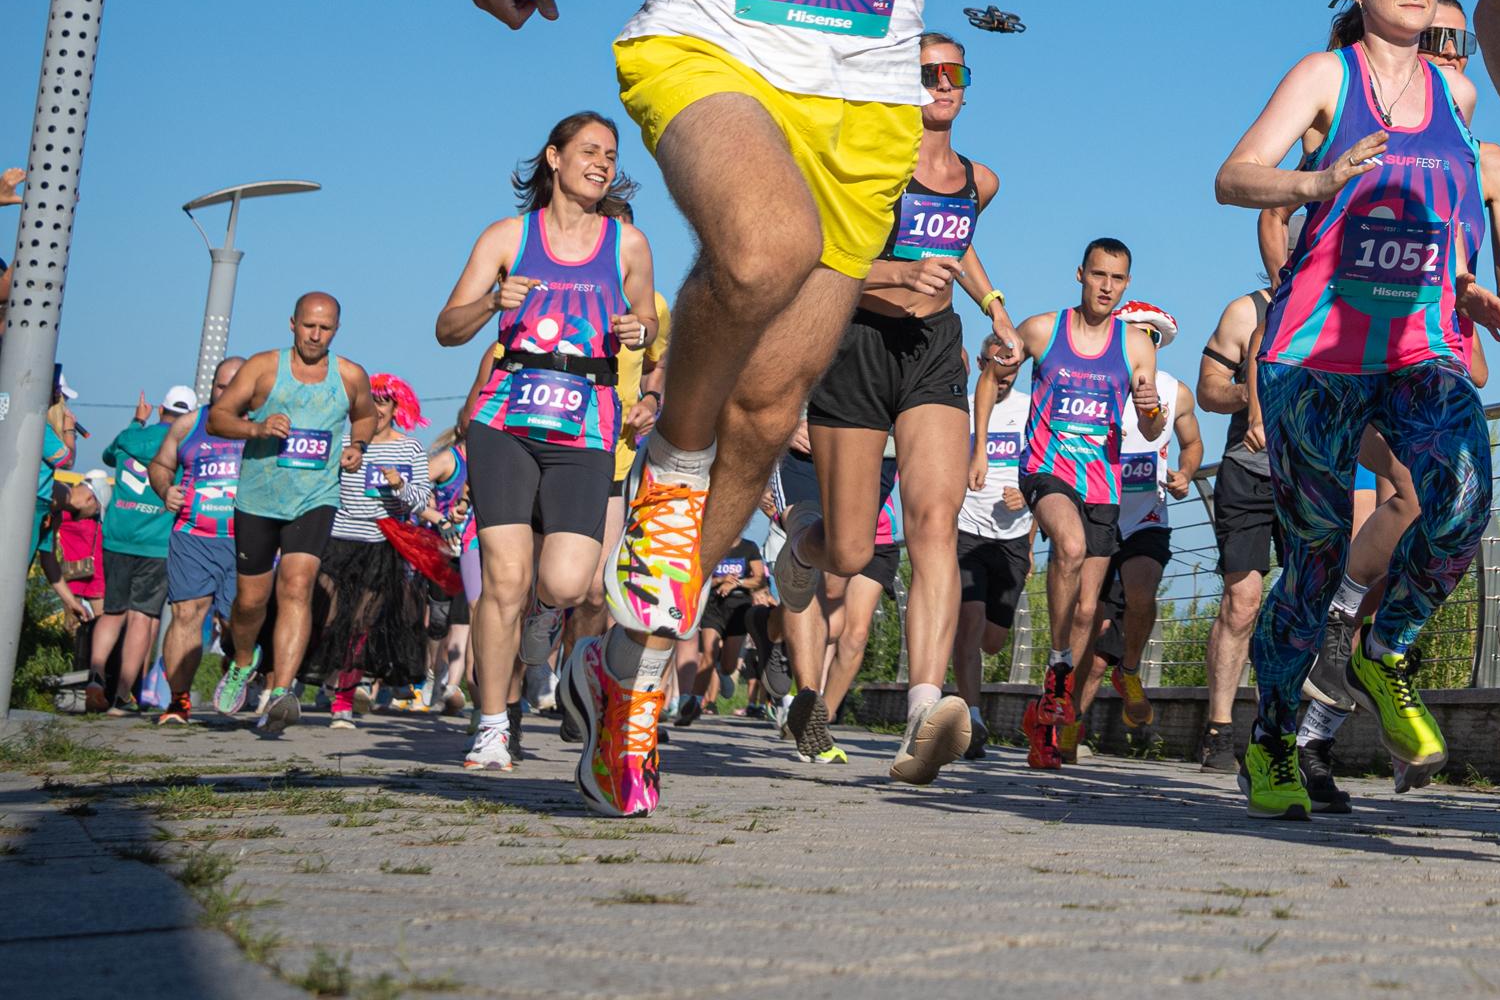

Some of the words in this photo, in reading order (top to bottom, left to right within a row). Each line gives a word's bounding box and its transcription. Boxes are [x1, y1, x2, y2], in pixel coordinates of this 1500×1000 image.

[787, 9, 853, 28] Hisense
[1384, 154, 1442, 169] SUPFEST
[909, 212, 971, 239] 1028
[1355, 239, 1439, 272] 1052
[1373, 286, 1418, 298] Hisense
[517, 383, 583, 412] 1019
[1058, 397, 1107, 418] 1041
[286, 437, 328, 455] 1033
[986, 440, 1016, 455] 040
[199, 462, 237, 477] 1011
[1121, 462, 1154, 478] 049
[201, 503, 235, 512] Hisen
[716, 564, 743, 574] 1050
